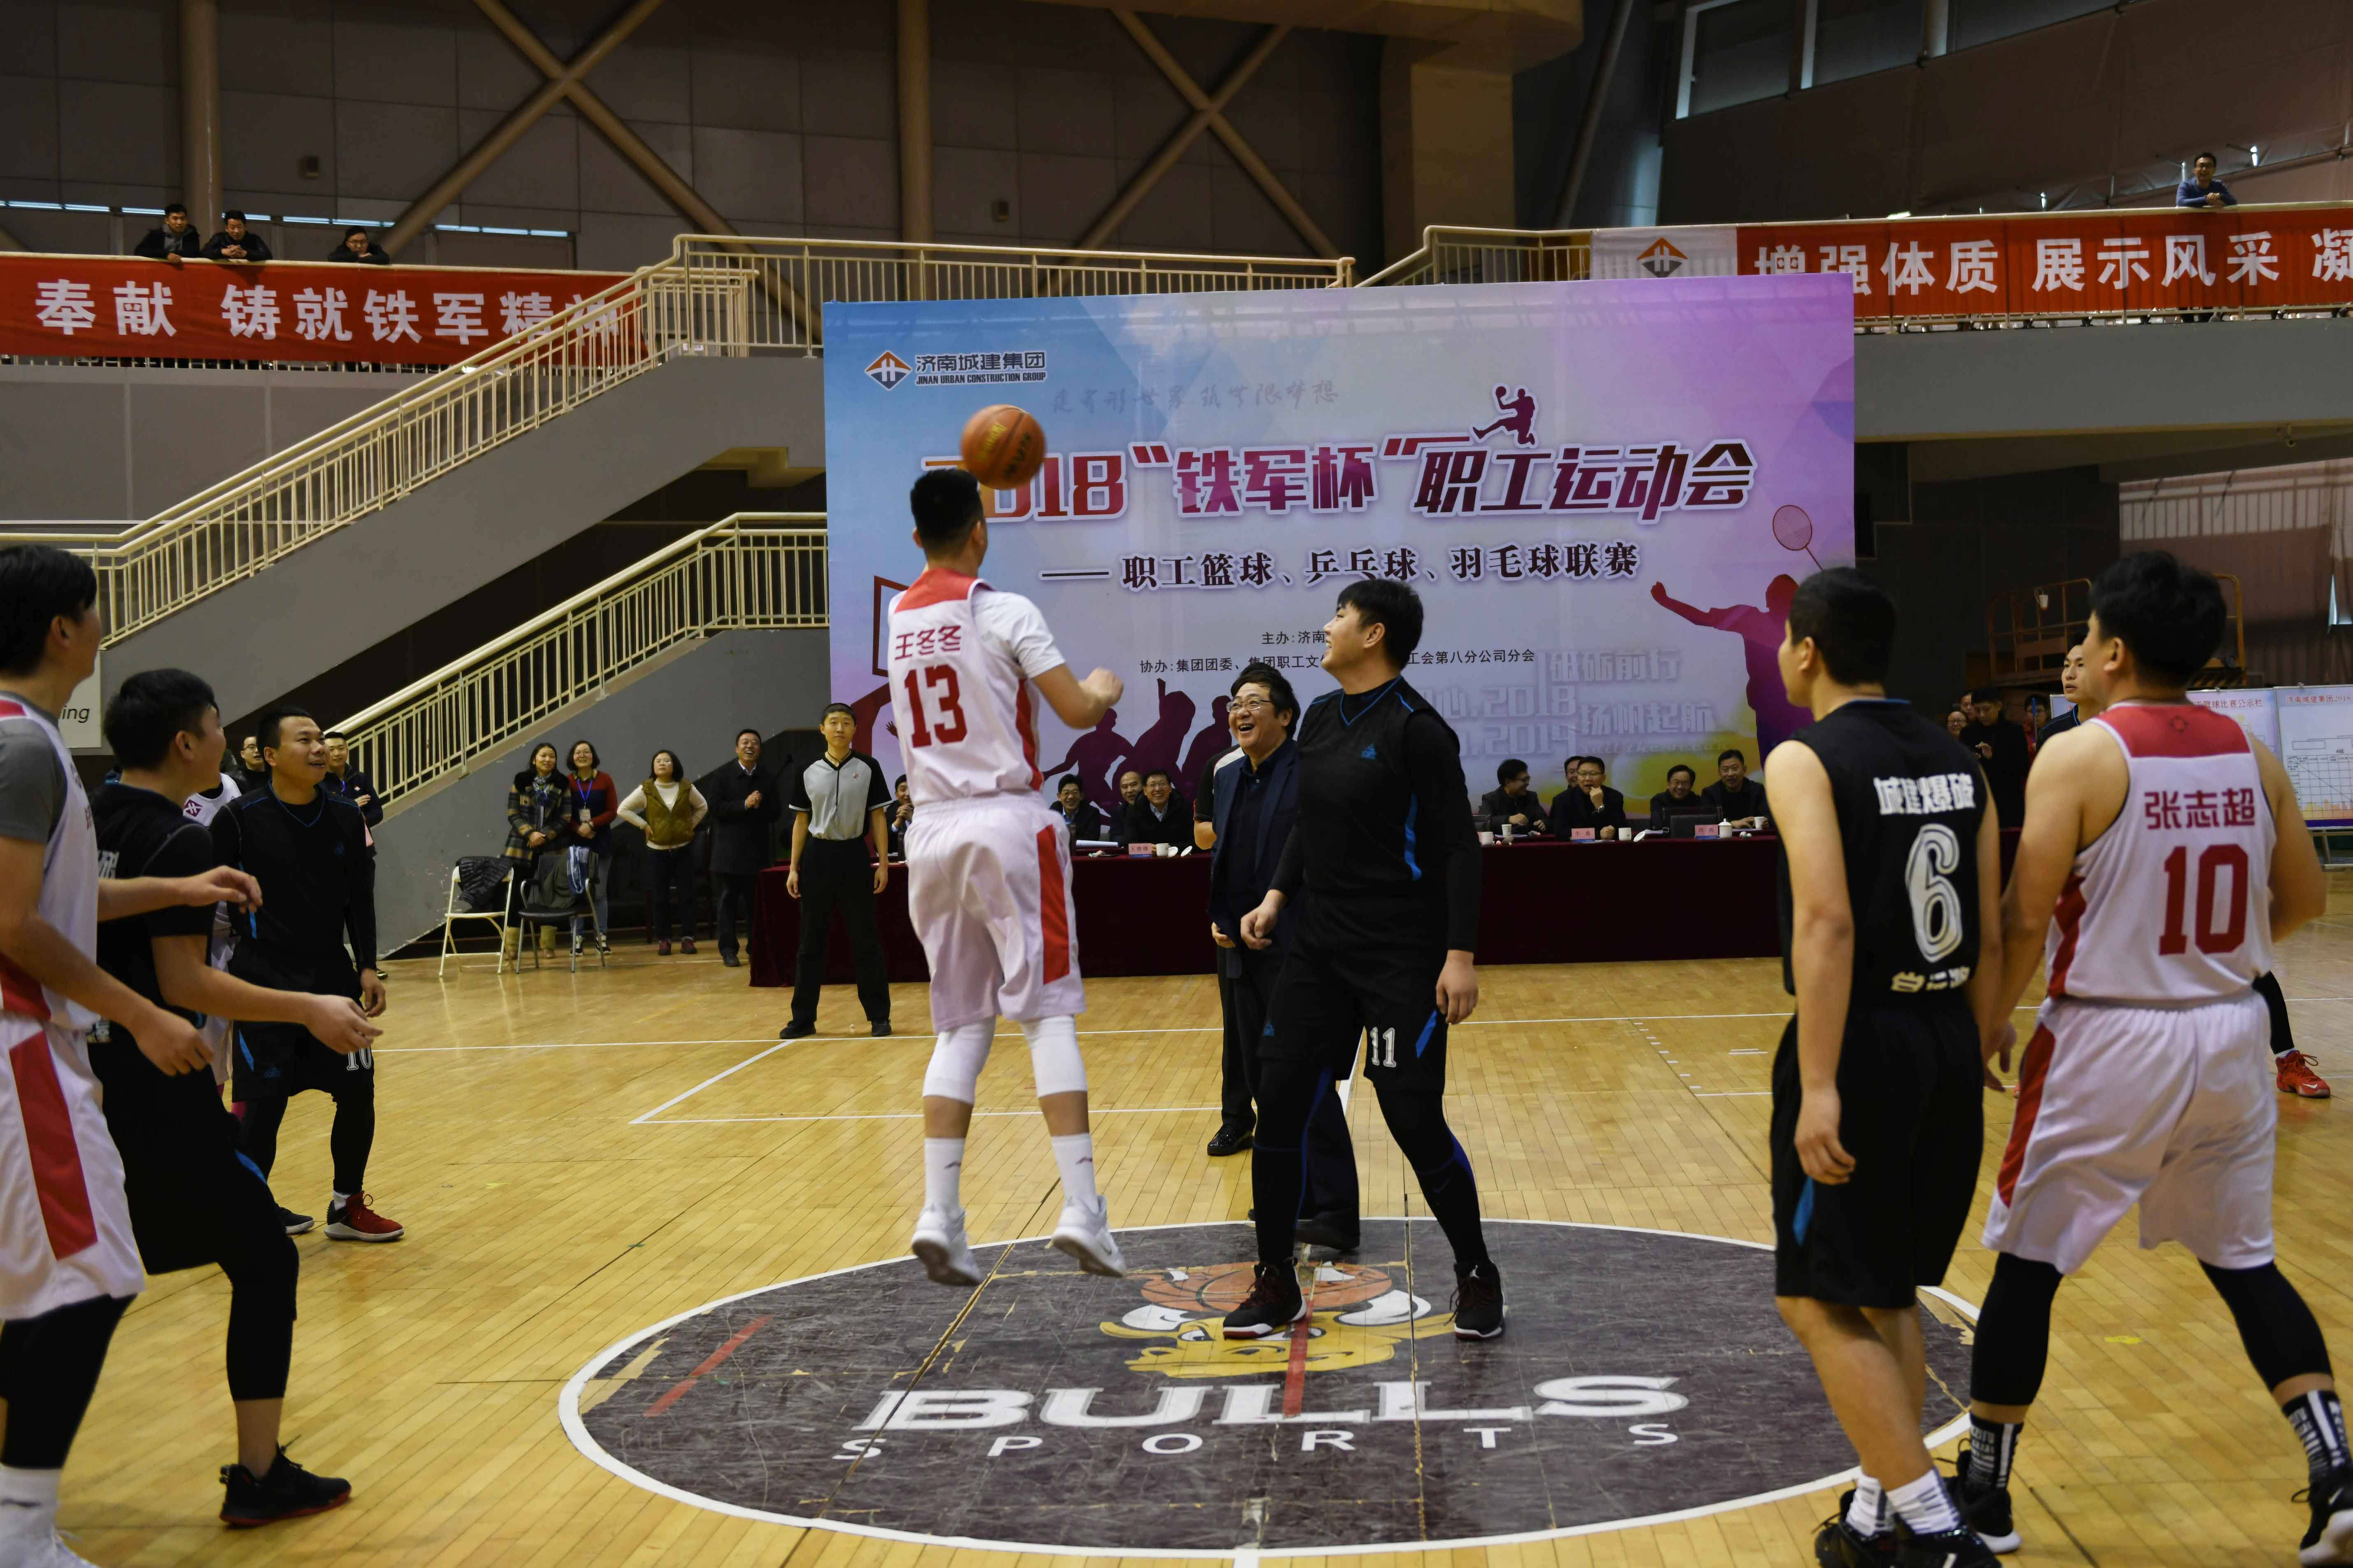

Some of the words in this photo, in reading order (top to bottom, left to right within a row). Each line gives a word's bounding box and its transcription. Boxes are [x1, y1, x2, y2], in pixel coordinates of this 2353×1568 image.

[1754, 239, 1998, 296] 增强体质
[2032, 230, 2280, 293] 展示风采
[35, 279, 177, 337] 奉献
[916, 352, 1045, 372] 济南城建集团
[916, 375, 938, 385] JINAN
[940, 374, 965, 384] URBAN
[967, 373, 1021, 383] CONSTRUCTION
[1022, 372, 1046, 382] GROUP
[894, 625, 962, 661] 王冬冬
[1408, 648, 1535, 665] 工会第八分公司分会
[904, 664, 967, 749] 13
[2144, 787, 2256, 830] 张志超
[1904, 823, 1963, 963] 6
[2159, 843, 2249, 956] 10
[1369, 1027, 1397, 1068] 11
[851, 1375, 1690, 1431] BULLS
